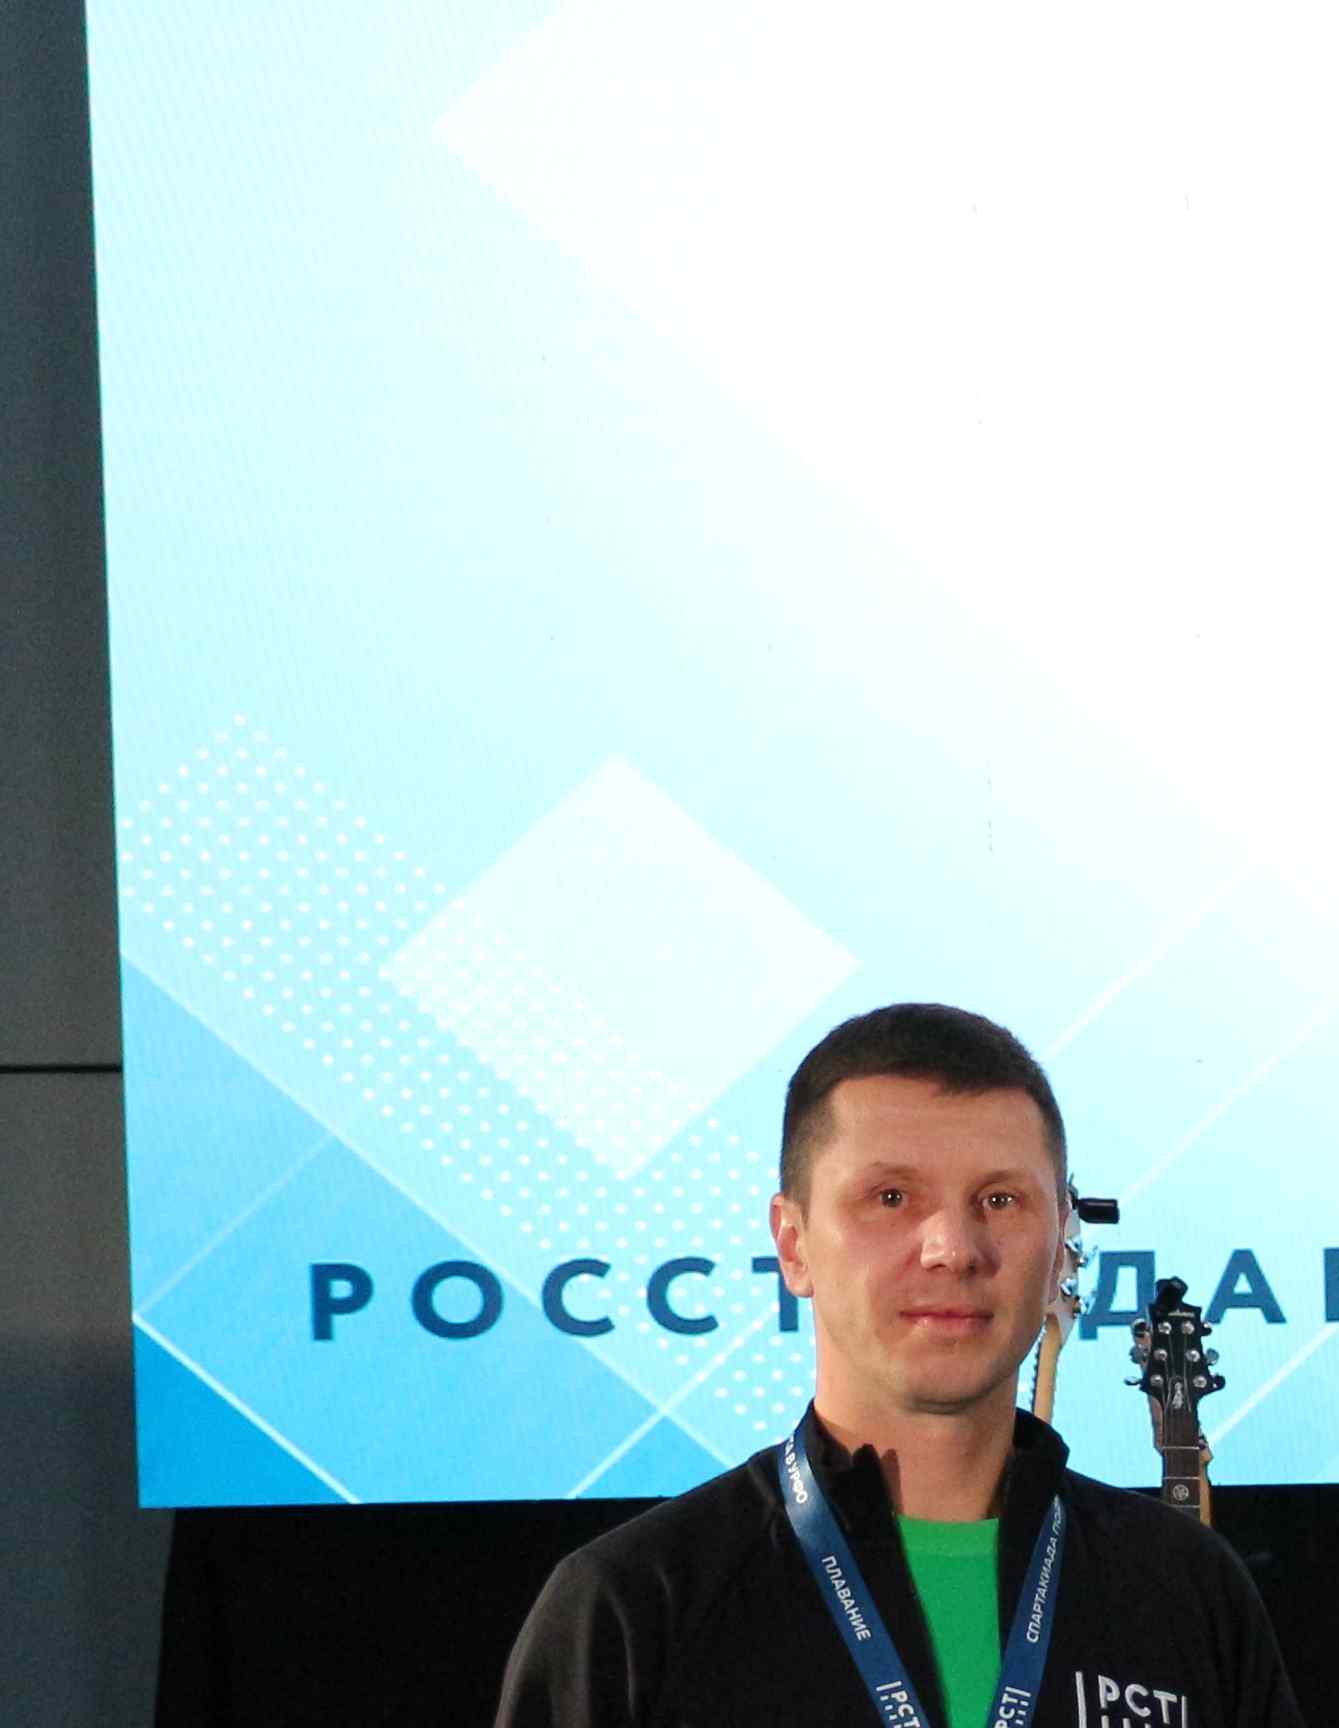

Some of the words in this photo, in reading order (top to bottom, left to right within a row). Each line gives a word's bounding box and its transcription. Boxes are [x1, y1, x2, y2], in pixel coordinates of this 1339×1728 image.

[790, 1465, 808, 1504] УРФО
[821, 1555, 872, 1641] ПЛАВАНИЕ
[1026, 1537, 1057, 1644] СПАРТАКИАДА
